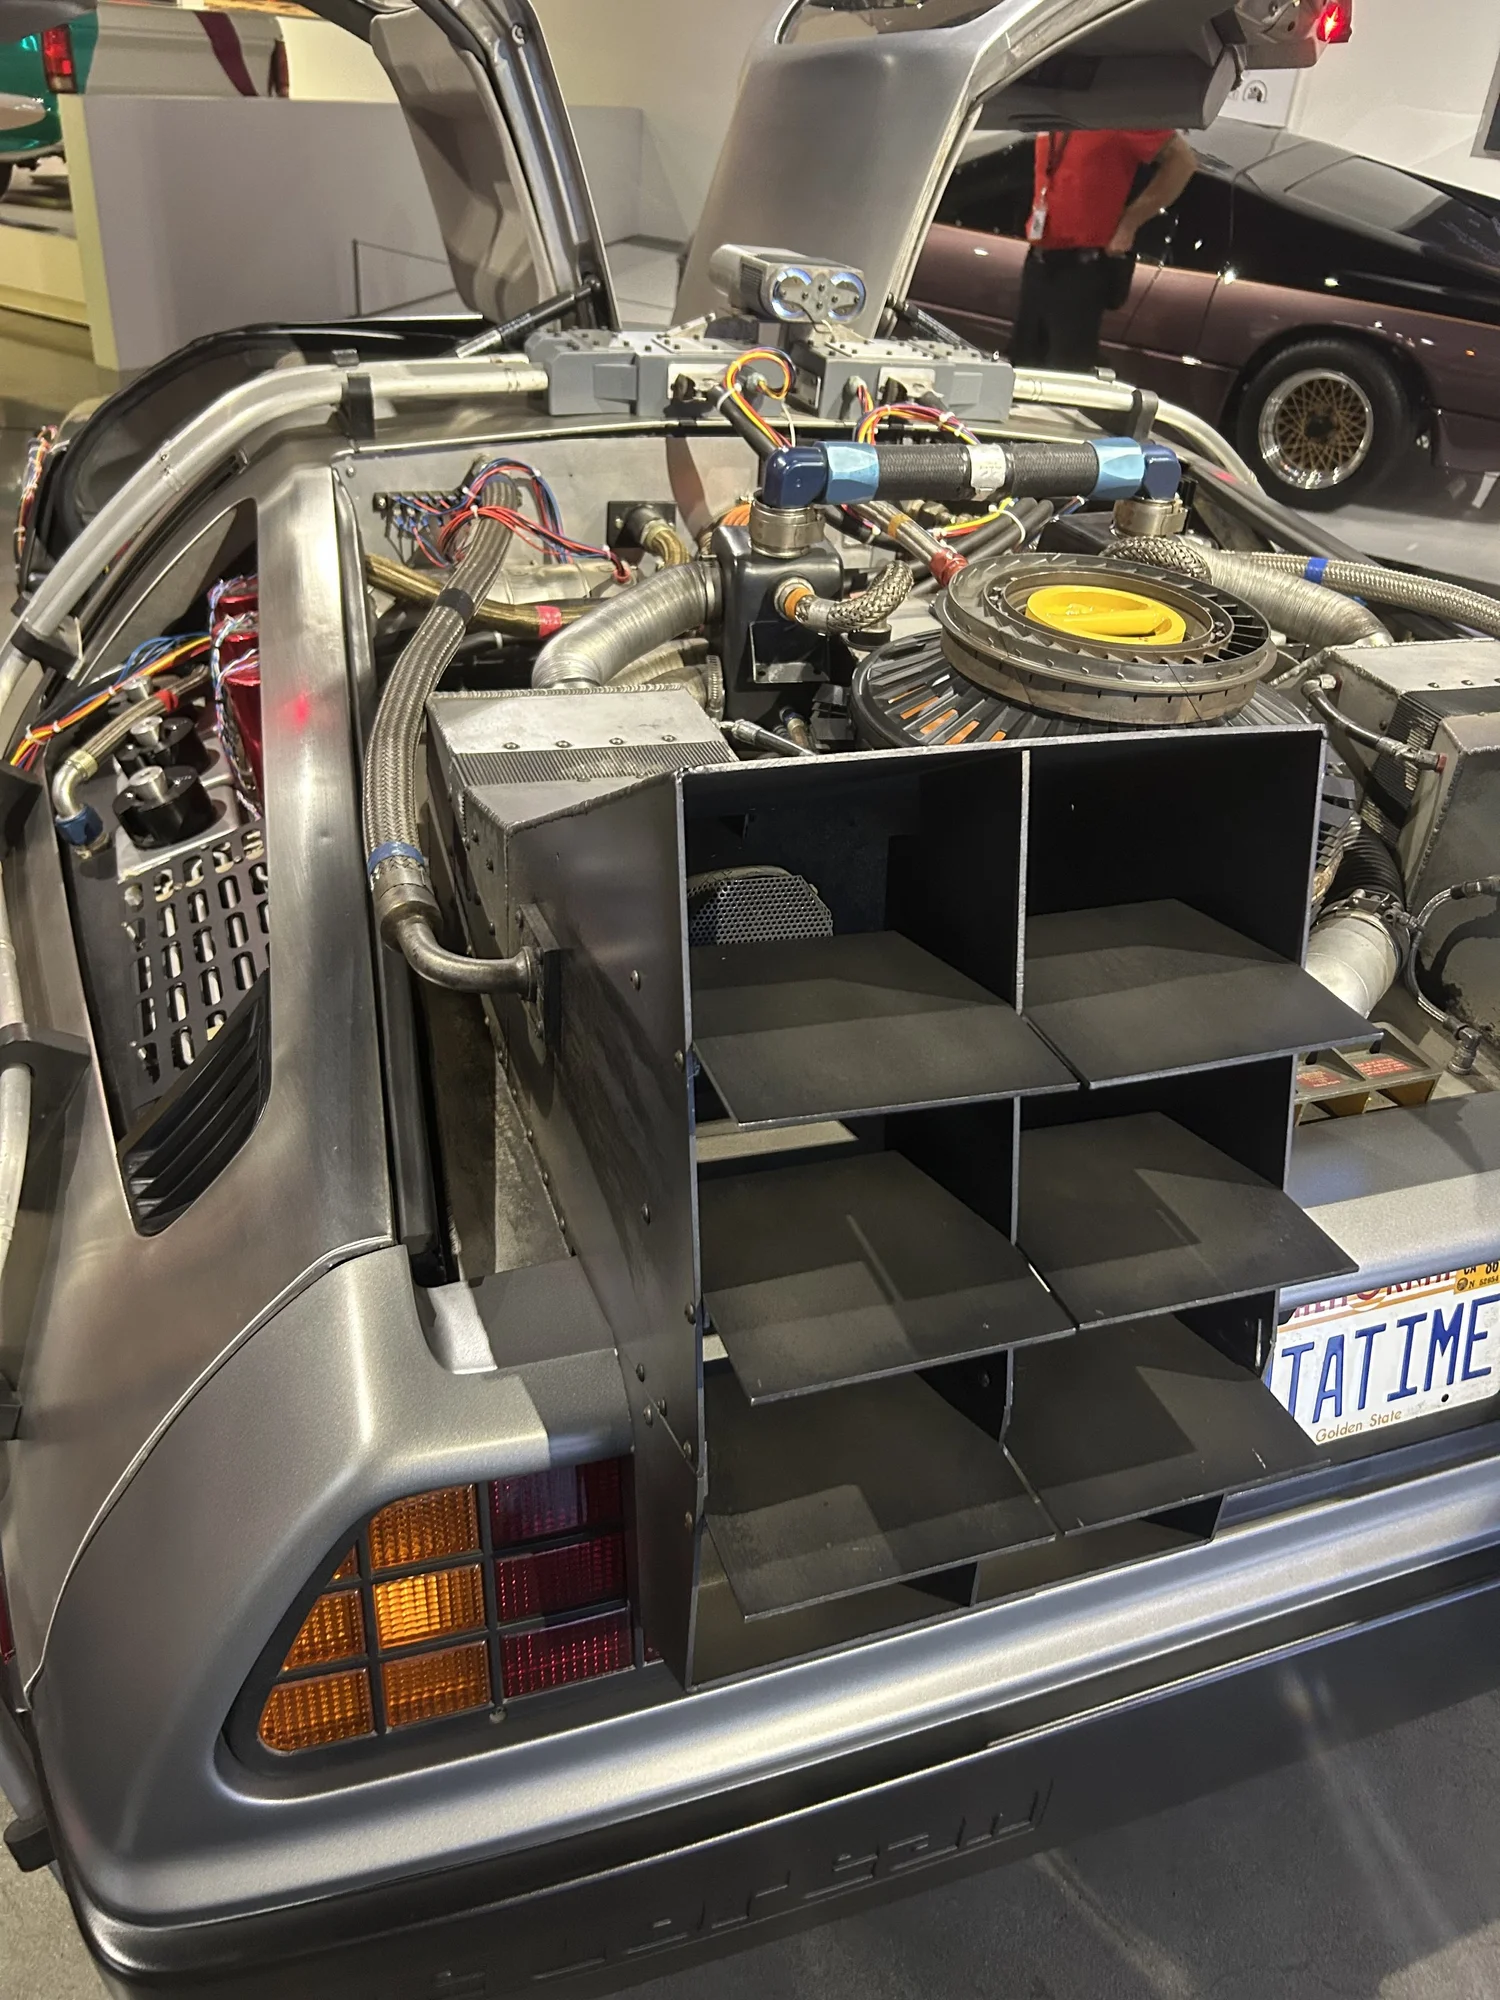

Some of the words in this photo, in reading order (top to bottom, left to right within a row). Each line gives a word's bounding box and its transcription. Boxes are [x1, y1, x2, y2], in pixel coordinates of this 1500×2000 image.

[1263, 1293, 1500, 1424] TATIME
[1315, 1422, 1363, 1442] Golden
[1370, 1410, 1402, 1427] State
